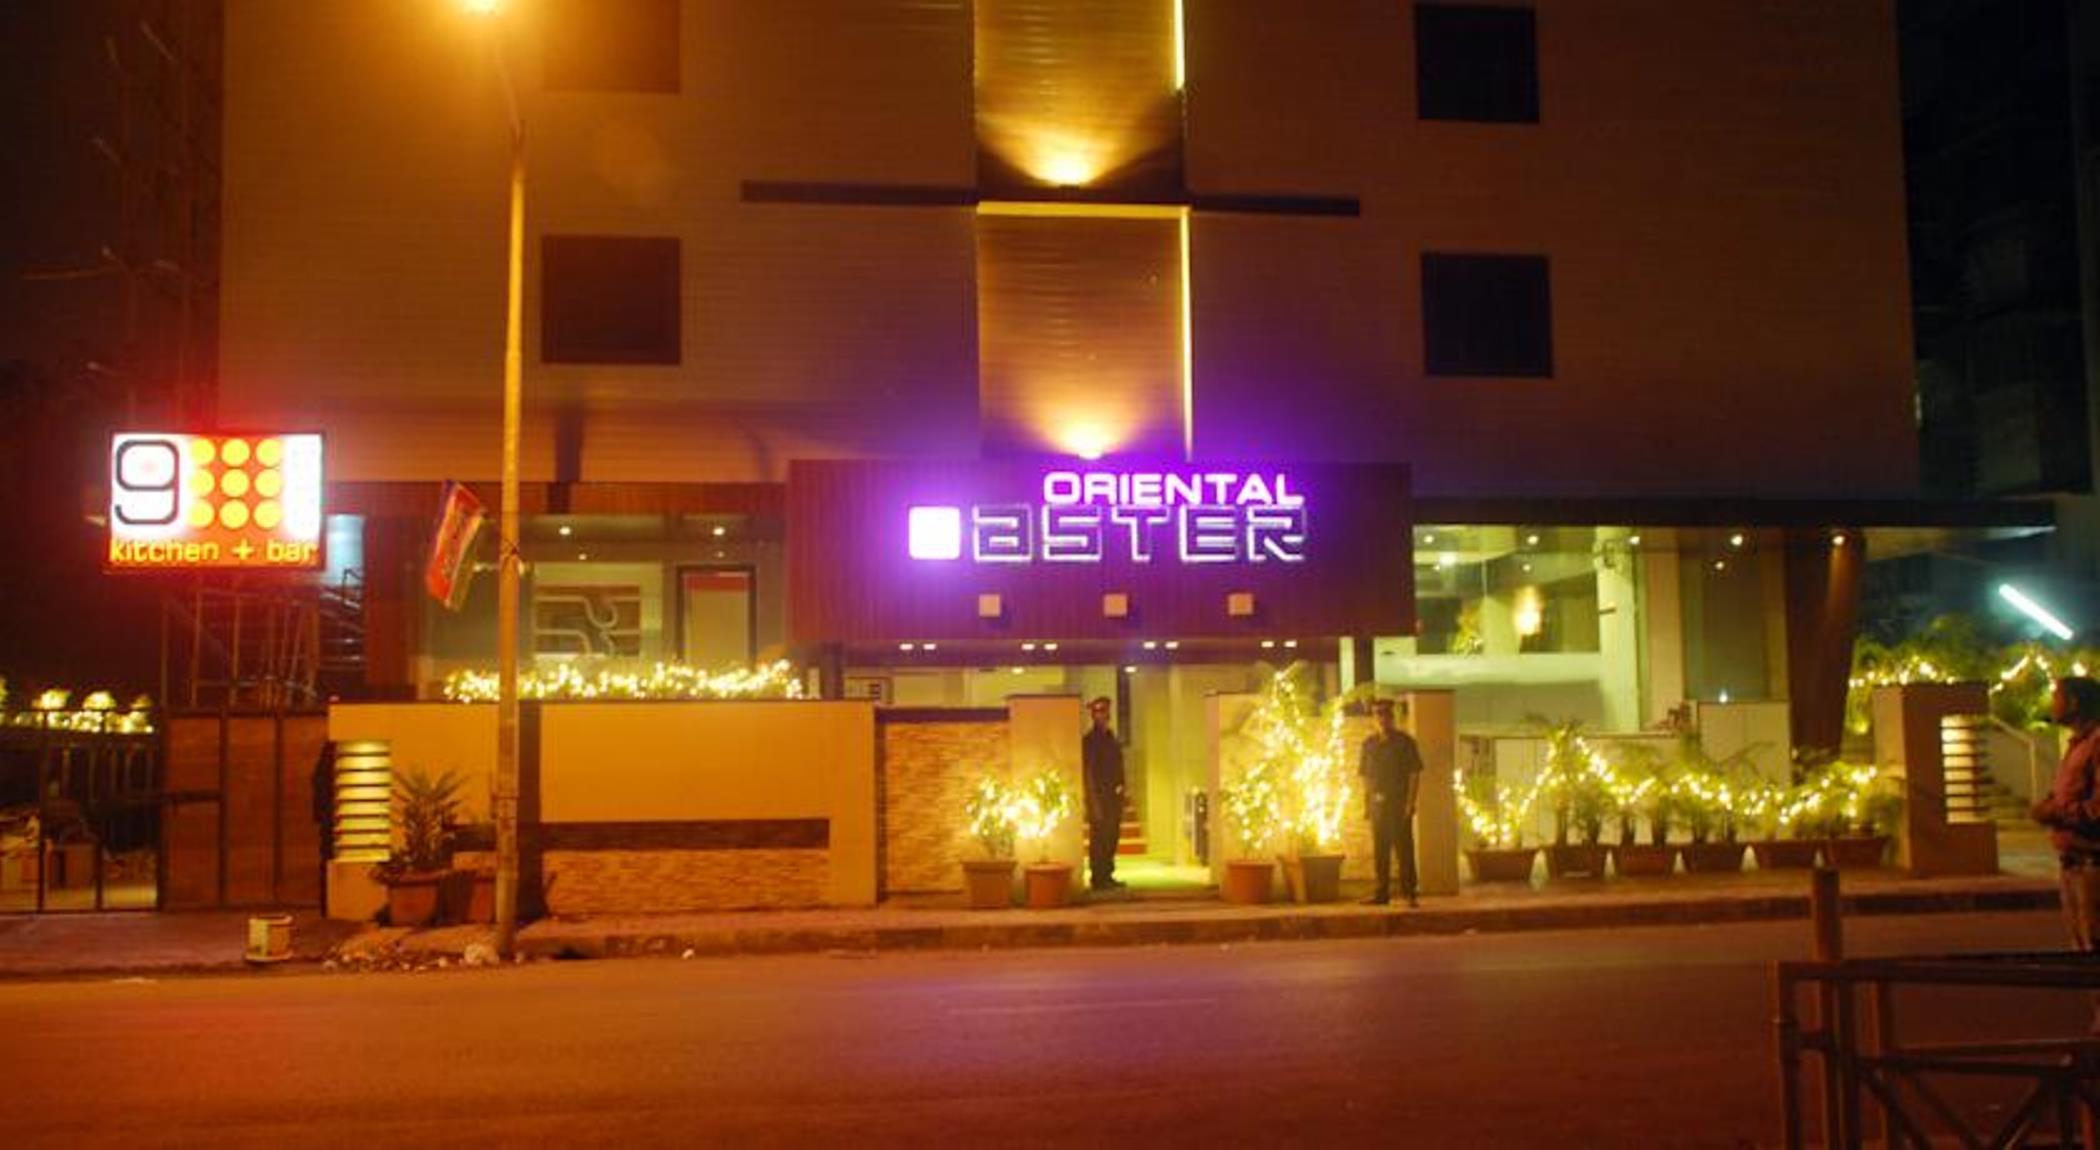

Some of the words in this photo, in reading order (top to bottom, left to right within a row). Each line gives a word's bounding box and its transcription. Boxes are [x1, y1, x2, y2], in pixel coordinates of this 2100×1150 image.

[1044, 472, 1304, 505] ORIENTAL
[110, 538, 219, 562] kitchen
[266, 538, 318, 562] bar
